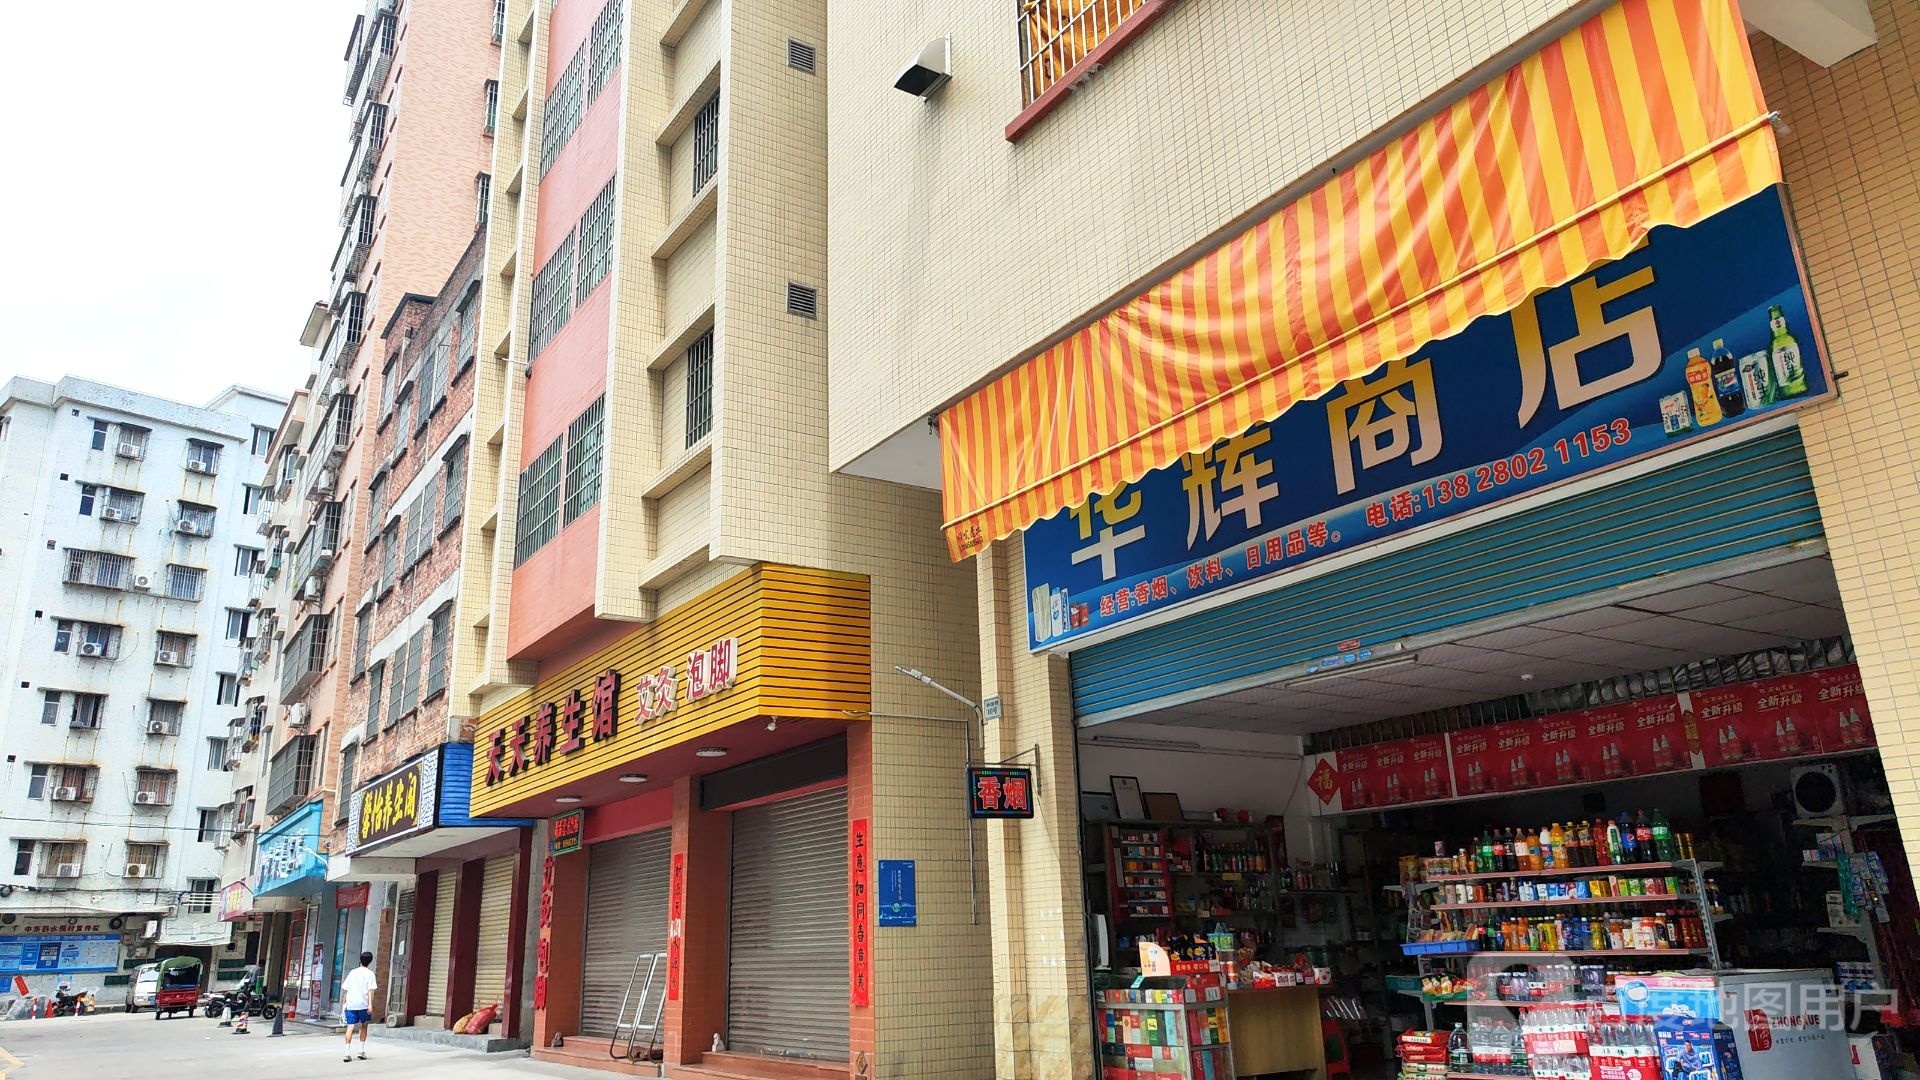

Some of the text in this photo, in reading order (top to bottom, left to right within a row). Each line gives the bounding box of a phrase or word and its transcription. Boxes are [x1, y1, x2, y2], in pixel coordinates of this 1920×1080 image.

[1069, 233, 1663, 582] 华辉商店
[1475, 447, 1547, 492] 2802
[1553, 417, 1631, 465] 1153
[634, 637, 738, 725] 艾灸 泡脚
[1757, 692, 1802, 710] 全新升级
[1700, 702, 1744, 719] 全新升级
[485, 669, 621, 787] 天天养生馆
[1587, 722, 1625, 736] 全新升级
[1636, 713, 1676, 728] 全新升级
[1497, 736, 1531, 749] 全新升级
[1541, 729, 1576, 743] 全新升级
[1413, 748, 1442, 761] 全新升级
[1455, 741, 1488, 754] 全新升级
[1316, 768, 1333, 791] 福
[978, 776, 1027, 810] 香烟
[854, 831, 866, 992] 生意如同春意美
